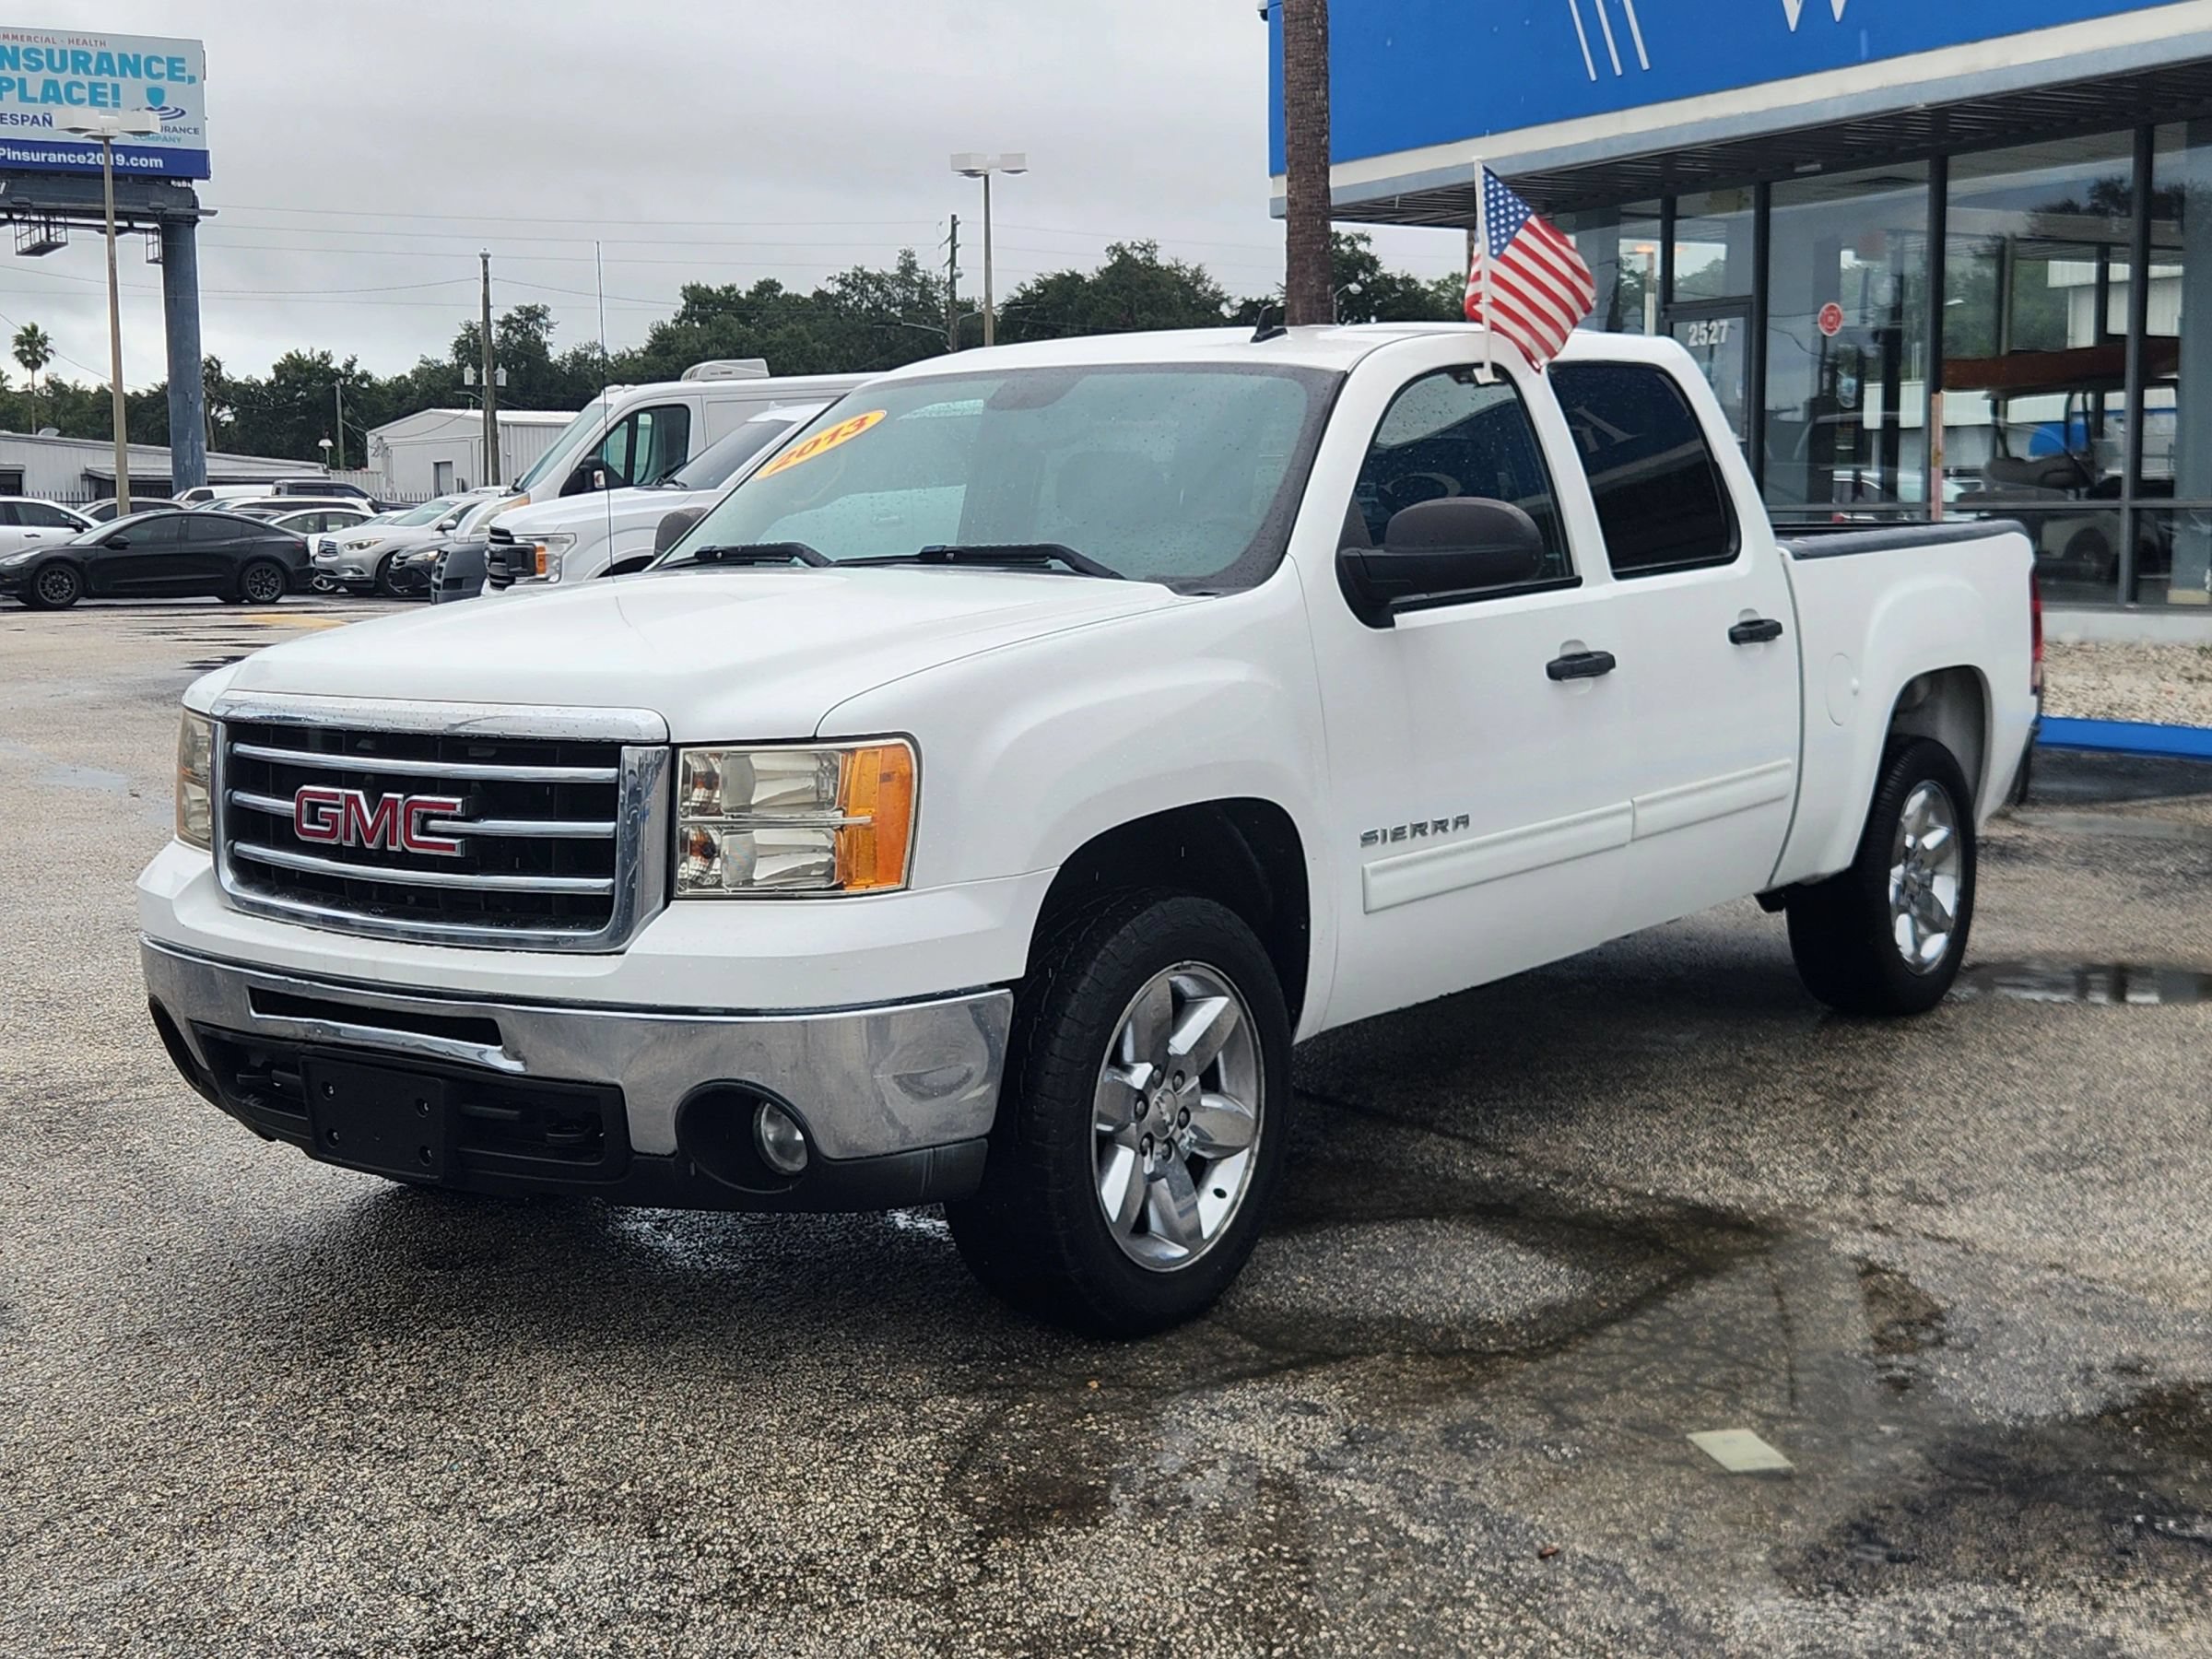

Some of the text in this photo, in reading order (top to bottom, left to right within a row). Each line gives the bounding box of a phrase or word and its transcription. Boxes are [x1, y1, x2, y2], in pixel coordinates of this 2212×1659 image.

[68, 38, 107, 47] HEALTH
[0, 44, 196, 84] NSURANCE,
[0, 75, 121, 108] PLACE!
[0, 112, 53, 127] ESPAÑ
[1688, 320, 1728, 347] 2527
[768, 416, 869, 474] 2013
[294, 784, 465, 857] GMC
[1359, 812, 1470, 848] SIERRA
